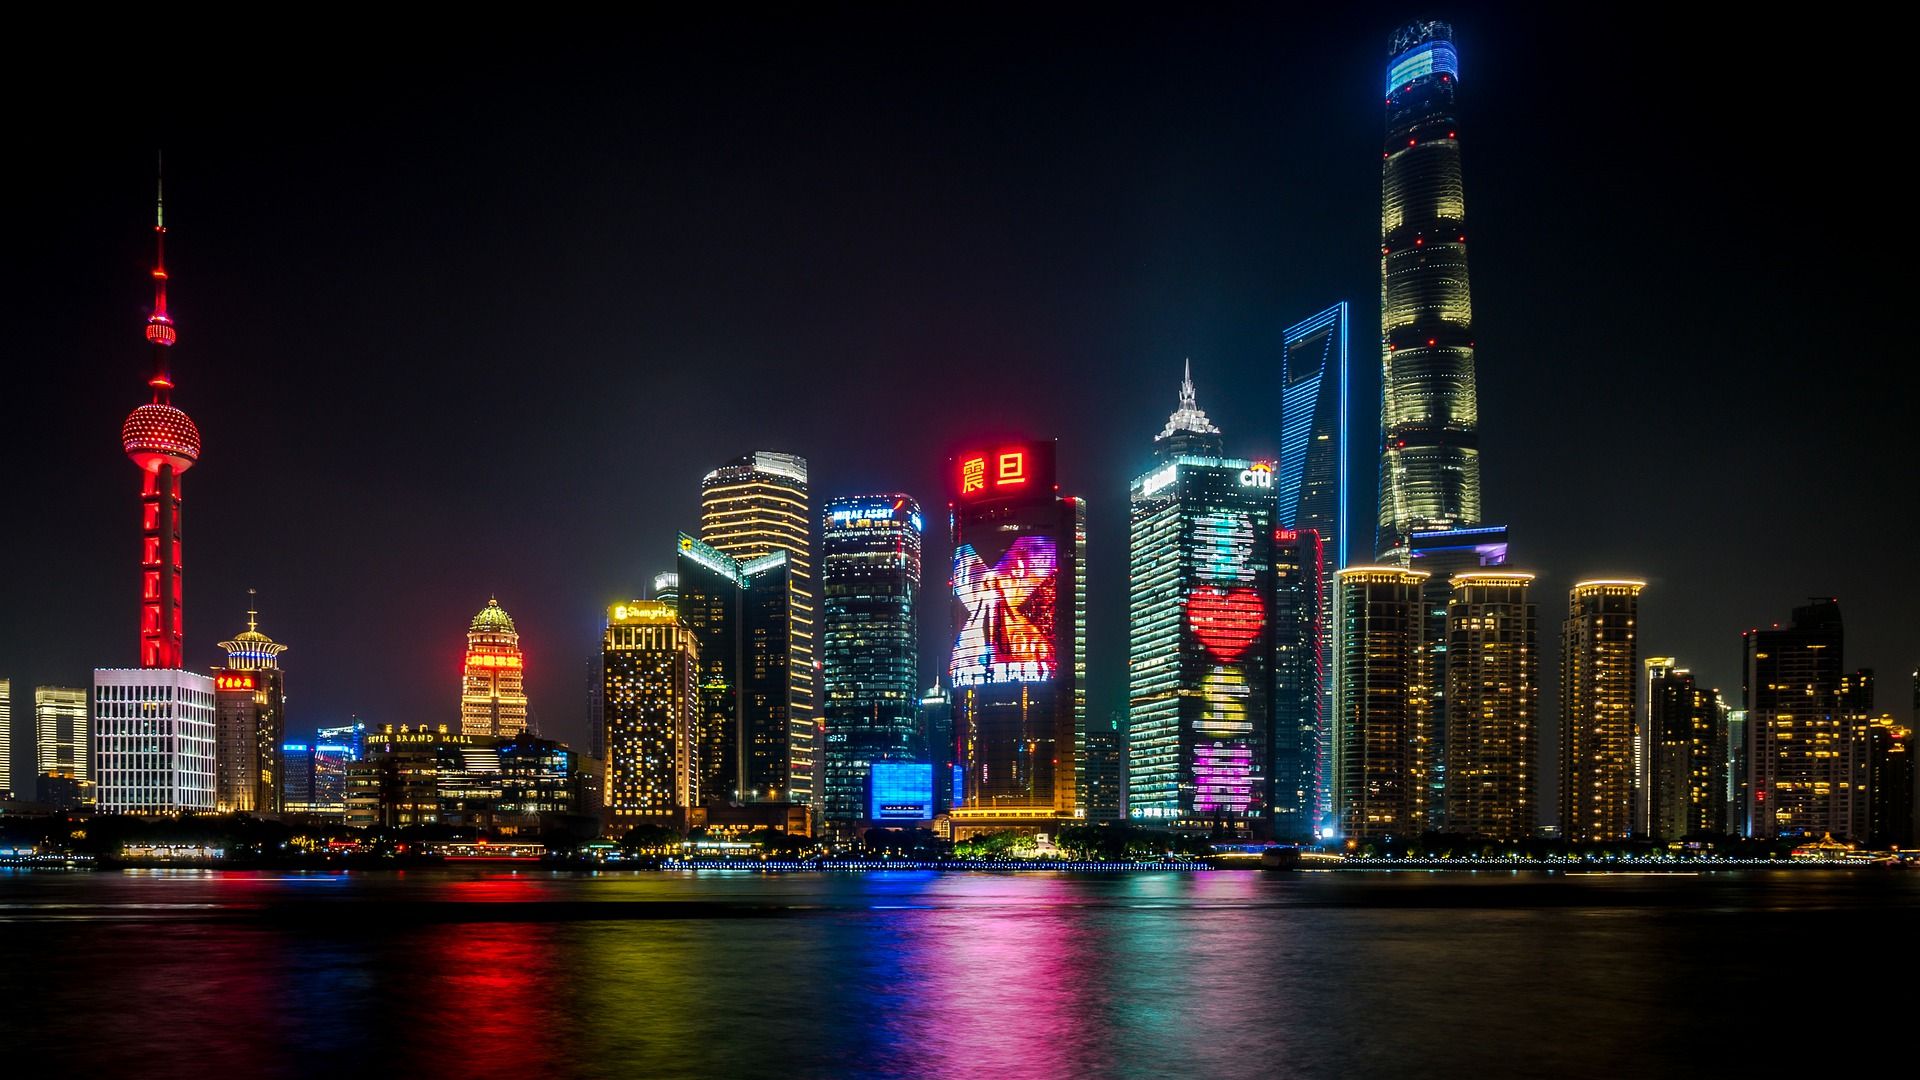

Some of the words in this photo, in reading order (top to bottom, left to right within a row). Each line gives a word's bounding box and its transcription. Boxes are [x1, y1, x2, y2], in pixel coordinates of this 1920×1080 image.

[962, 453, 1026, 494] 震旦
[1240, 466, 1272, 488] citi
[864, 509, 894, 519] ASSET
[368, 735, 390, 743] SUPER
[396, 734, 434, 743] BRAND
[442, 735, 473, 744] MALL
